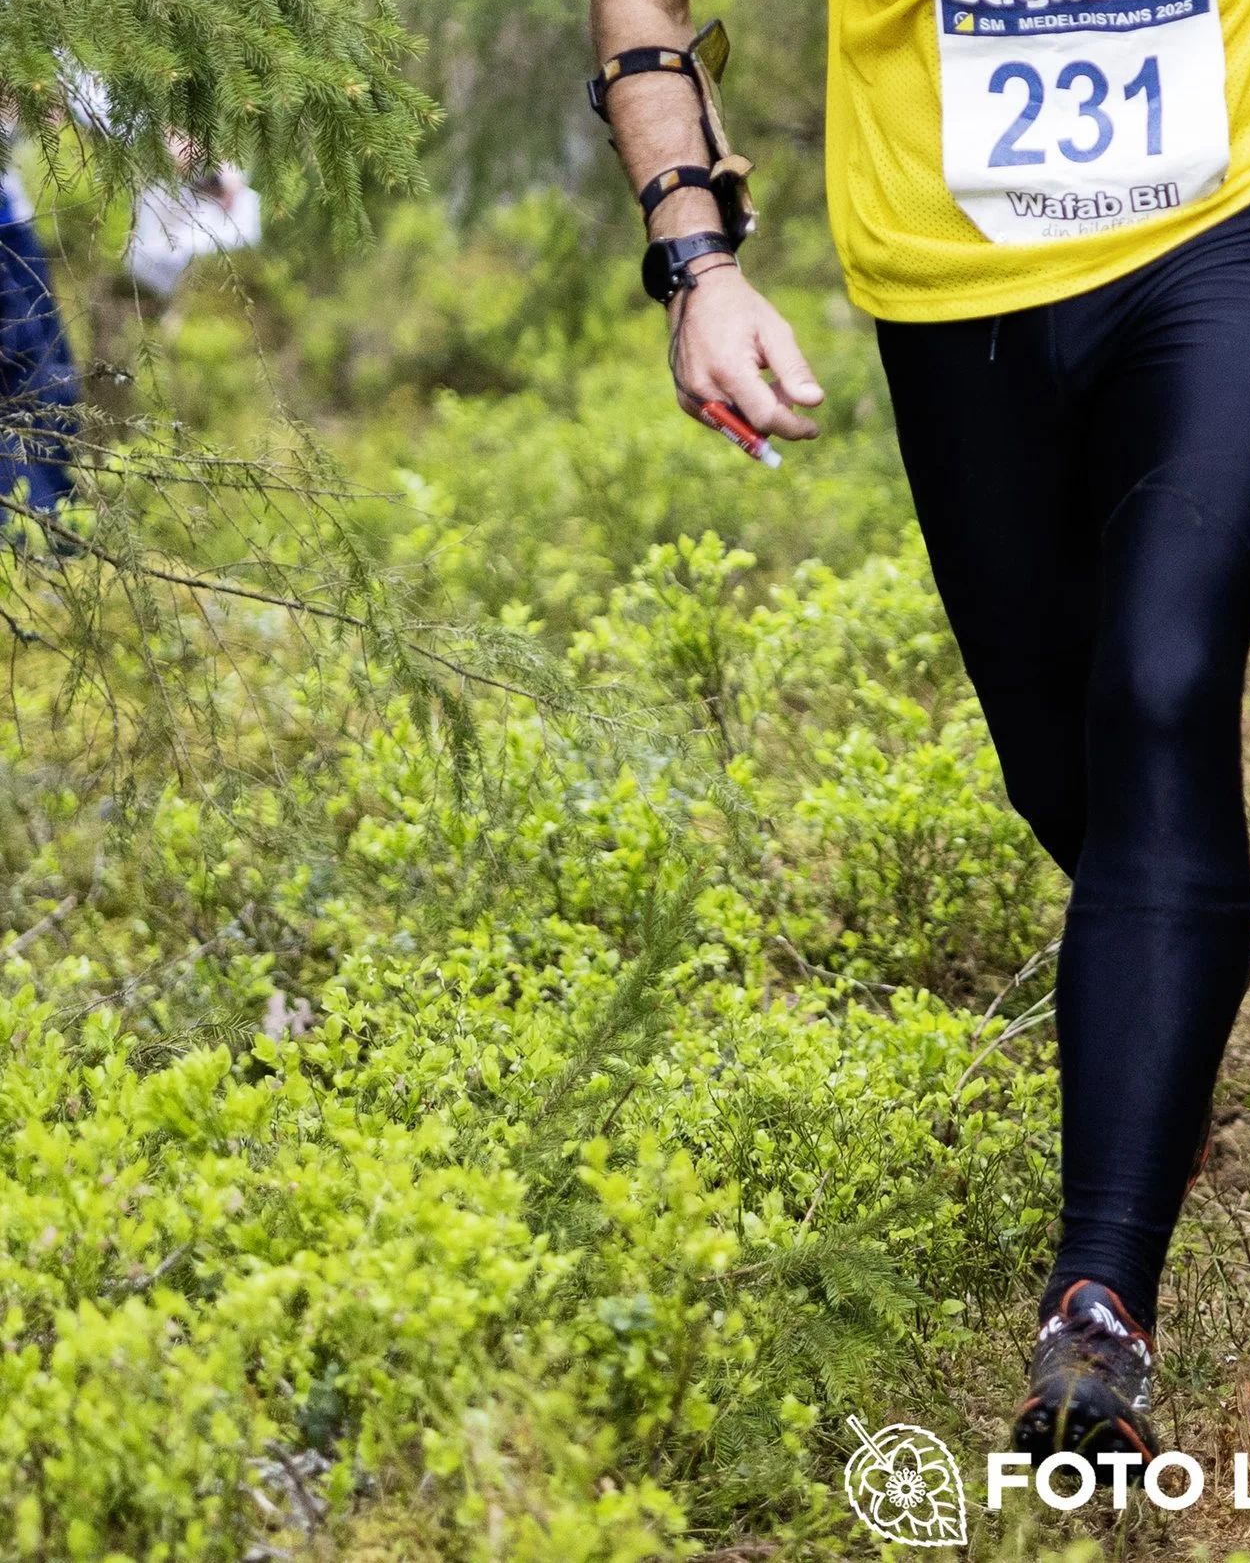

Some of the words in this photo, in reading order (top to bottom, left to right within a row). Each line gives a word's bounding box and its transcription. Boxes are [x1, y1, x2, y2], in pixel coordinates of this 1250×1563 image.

[979, 17, 1005, 31] SM
[1018, 10, 1151, 31] MEDELDISTANS
[1156, 0, 1193, 20] 2025
[987, 54, 1163, 168] 231
[1007, 190, 1123, 220] Wafab
[1130, 182, 1181, 213] Bil
